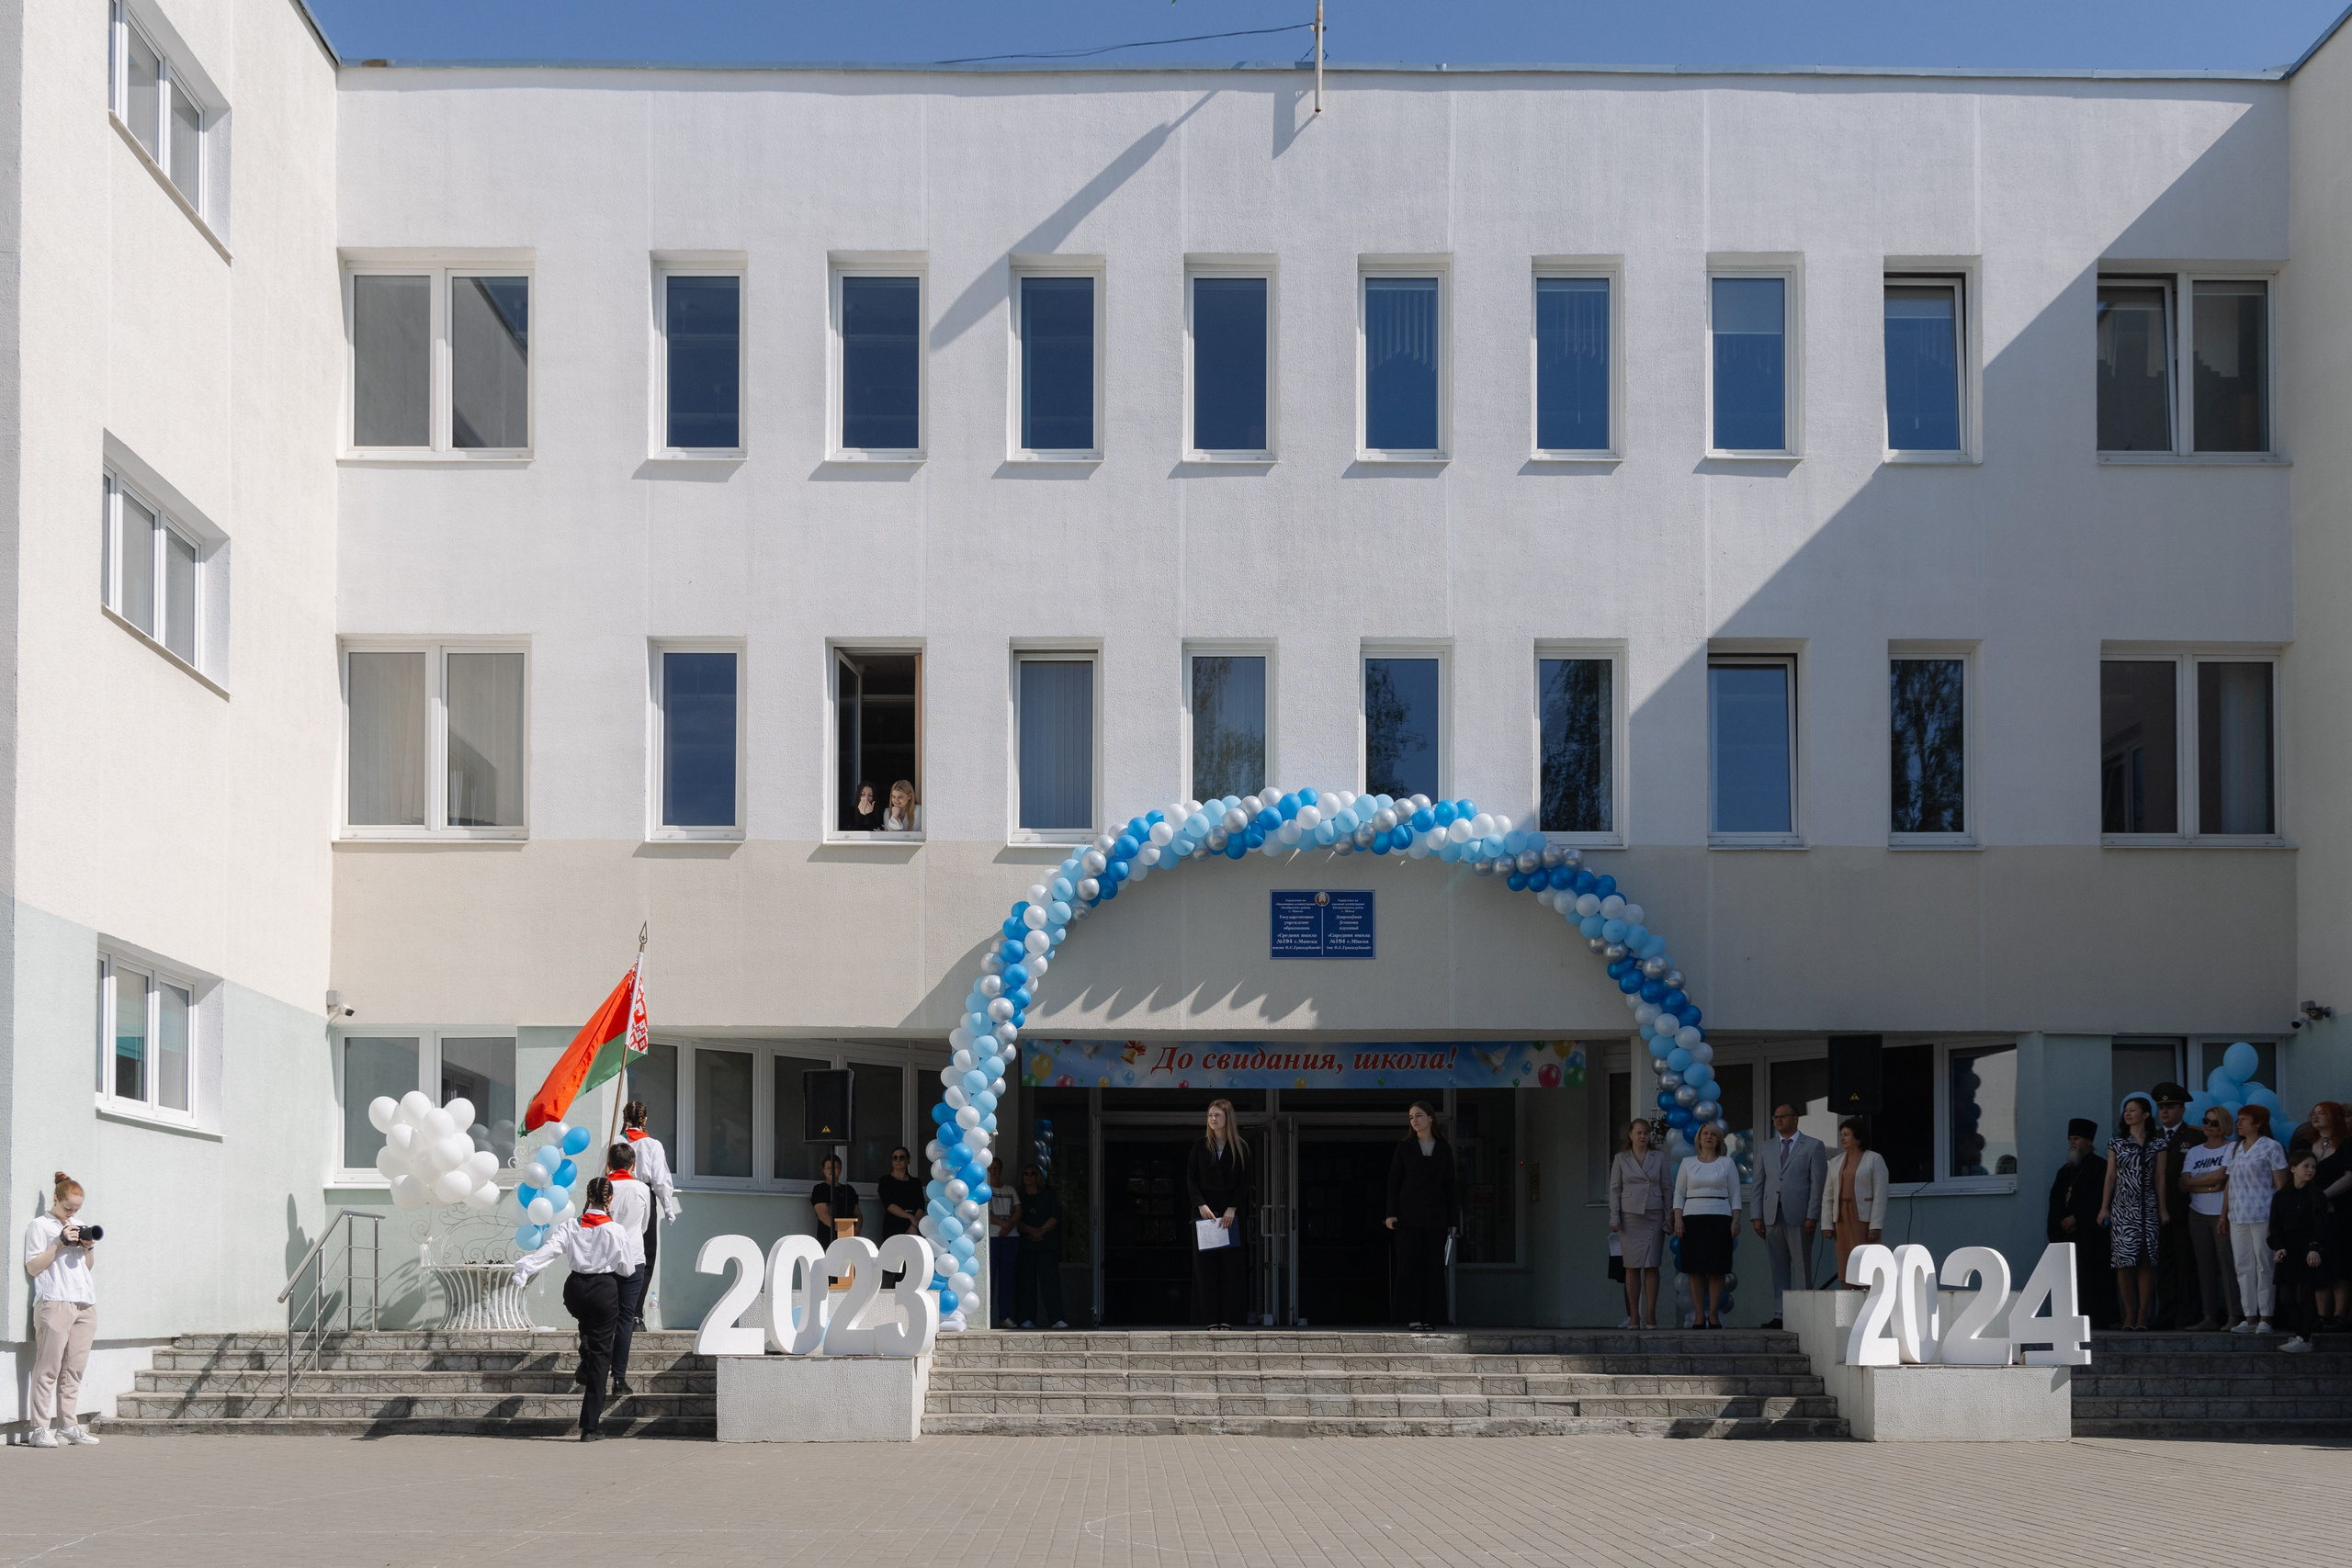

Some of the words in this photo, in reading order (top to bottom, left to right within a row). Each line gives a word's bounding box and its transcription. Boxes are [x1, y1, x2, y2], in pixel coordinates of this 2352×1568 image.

[1150, 1046, 1194, 1075] До
[1202, 1046, 1344, 1075] свидания,
[1352, 1046, 1458, 1070] школа!
[693, 1234, 937, 1356] 2023
[1845, 1242, 2092, 1366] 2024
